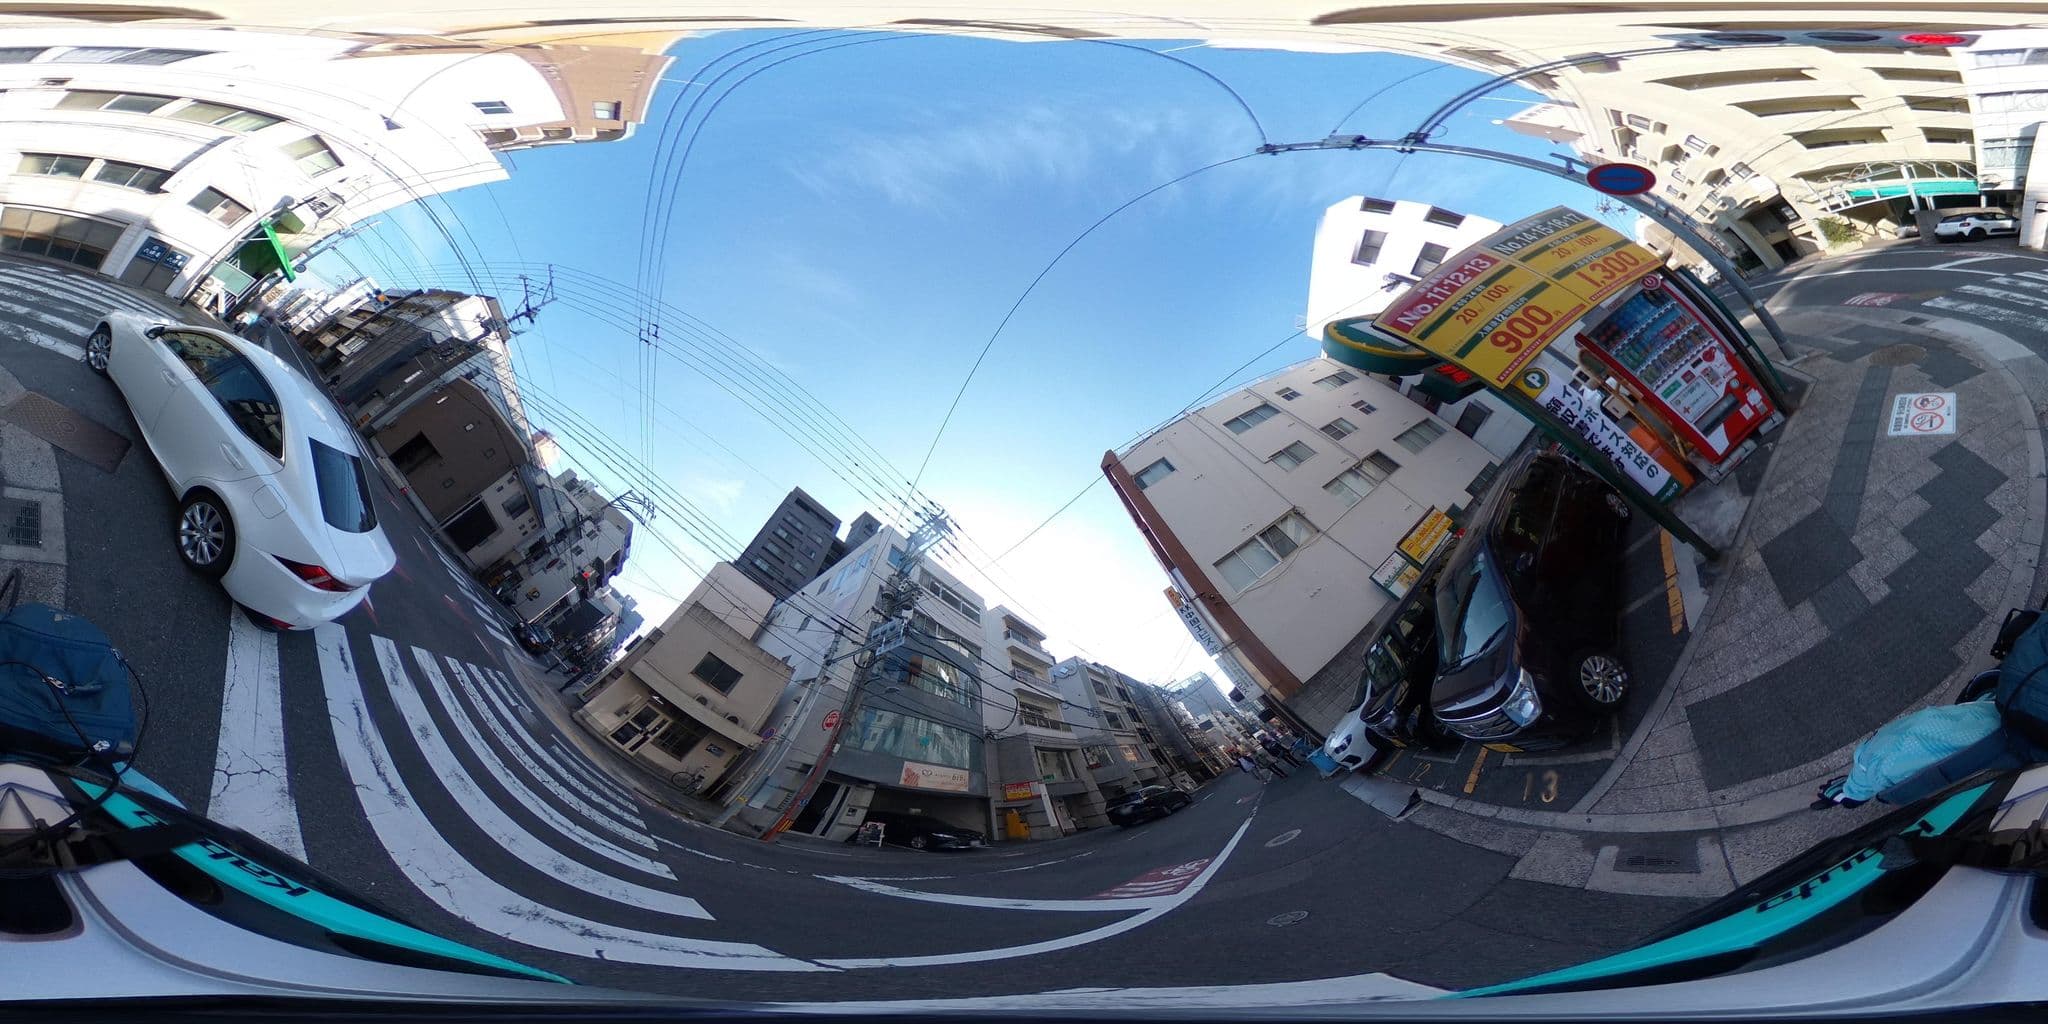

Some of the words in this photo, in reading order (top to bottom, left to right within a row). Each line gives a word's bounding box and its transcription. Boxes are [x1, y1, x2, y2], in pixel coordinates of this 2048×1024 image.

[1563, 385, 1659, 478] インボイス対応の
[1523, 770, 1558, 802] 13
